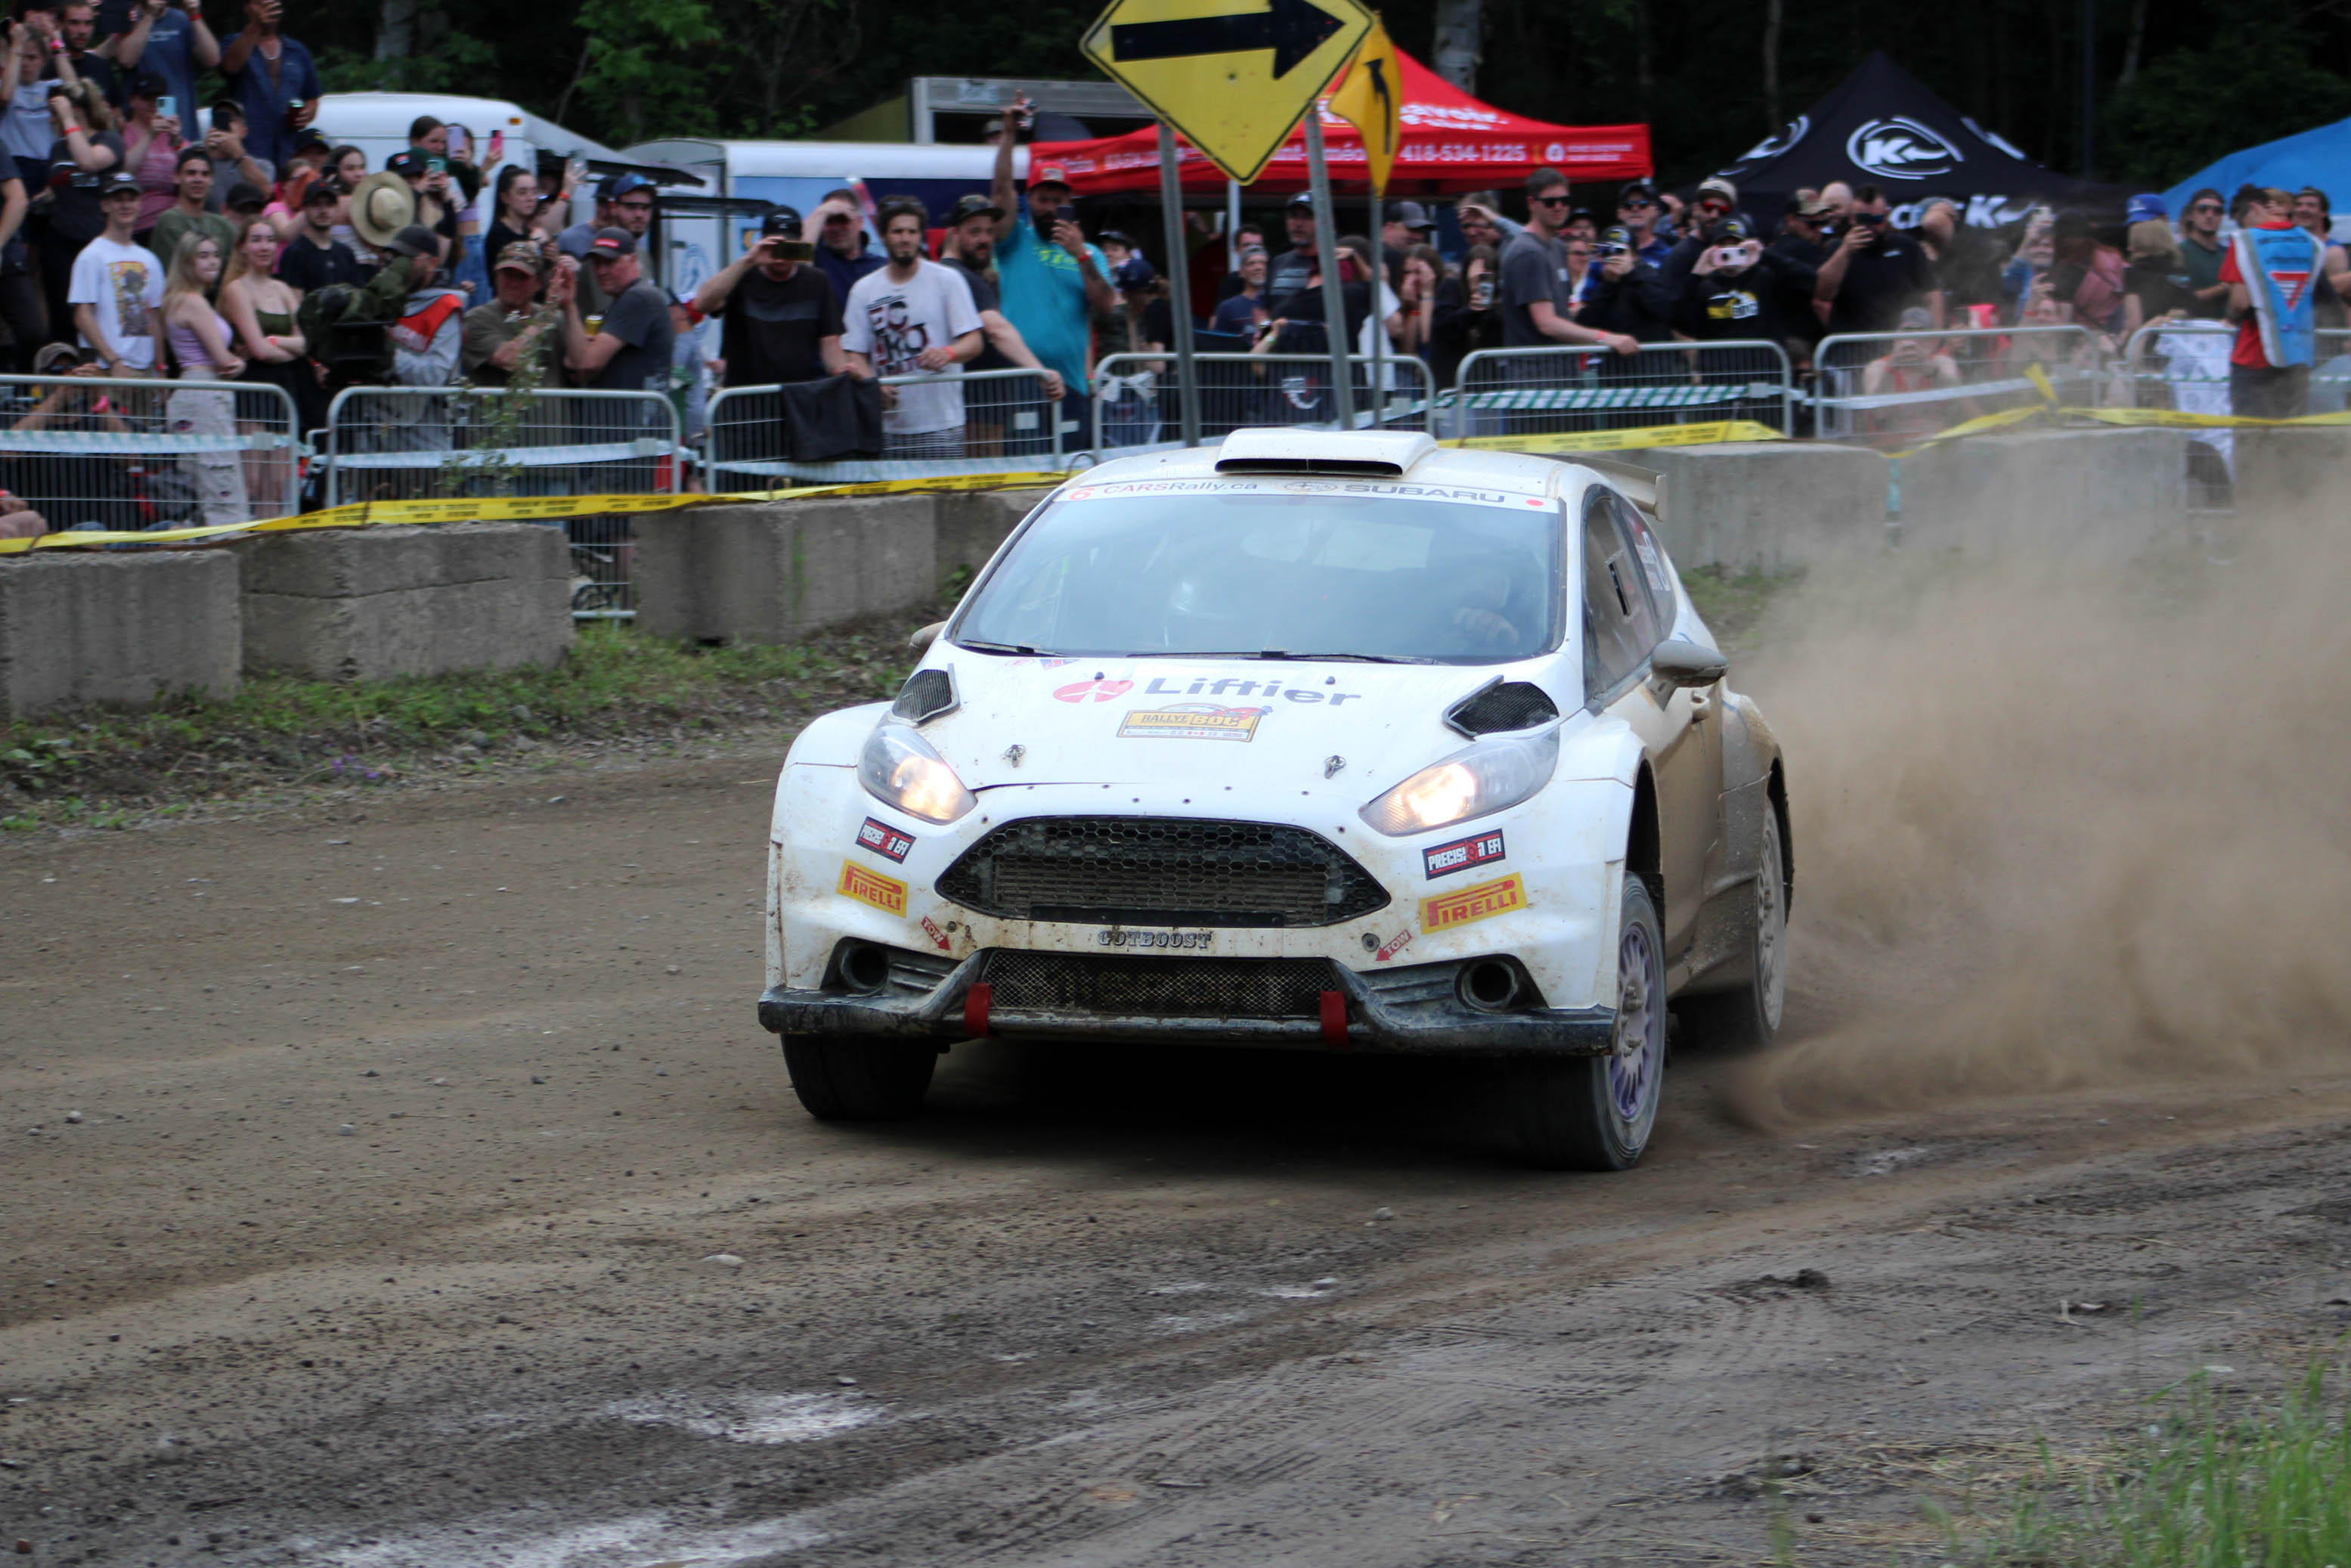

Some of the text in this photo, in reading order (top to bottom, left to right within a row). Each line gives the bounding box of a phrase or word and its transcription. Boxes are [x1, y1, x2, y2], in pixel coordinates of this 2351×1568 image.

[1103, 482, 1258, 494] CARSRally.ca
[1345, 485, 1505, 503] SUBARU
[1144, 677, 1361, 706] Liftier
[1141, 714, 1189, 724] RALLYE
[1488, 837, 1501, 855] EFI
[843, 865, 902, 911] PIRELLI
[1426, 879, 1517, 927] PIRELLI
[923, 919, 944, 943] TOW
[1098, 929, 1212, 949] GOTBOOST
[1383, 931, 1410, 954] TOW
